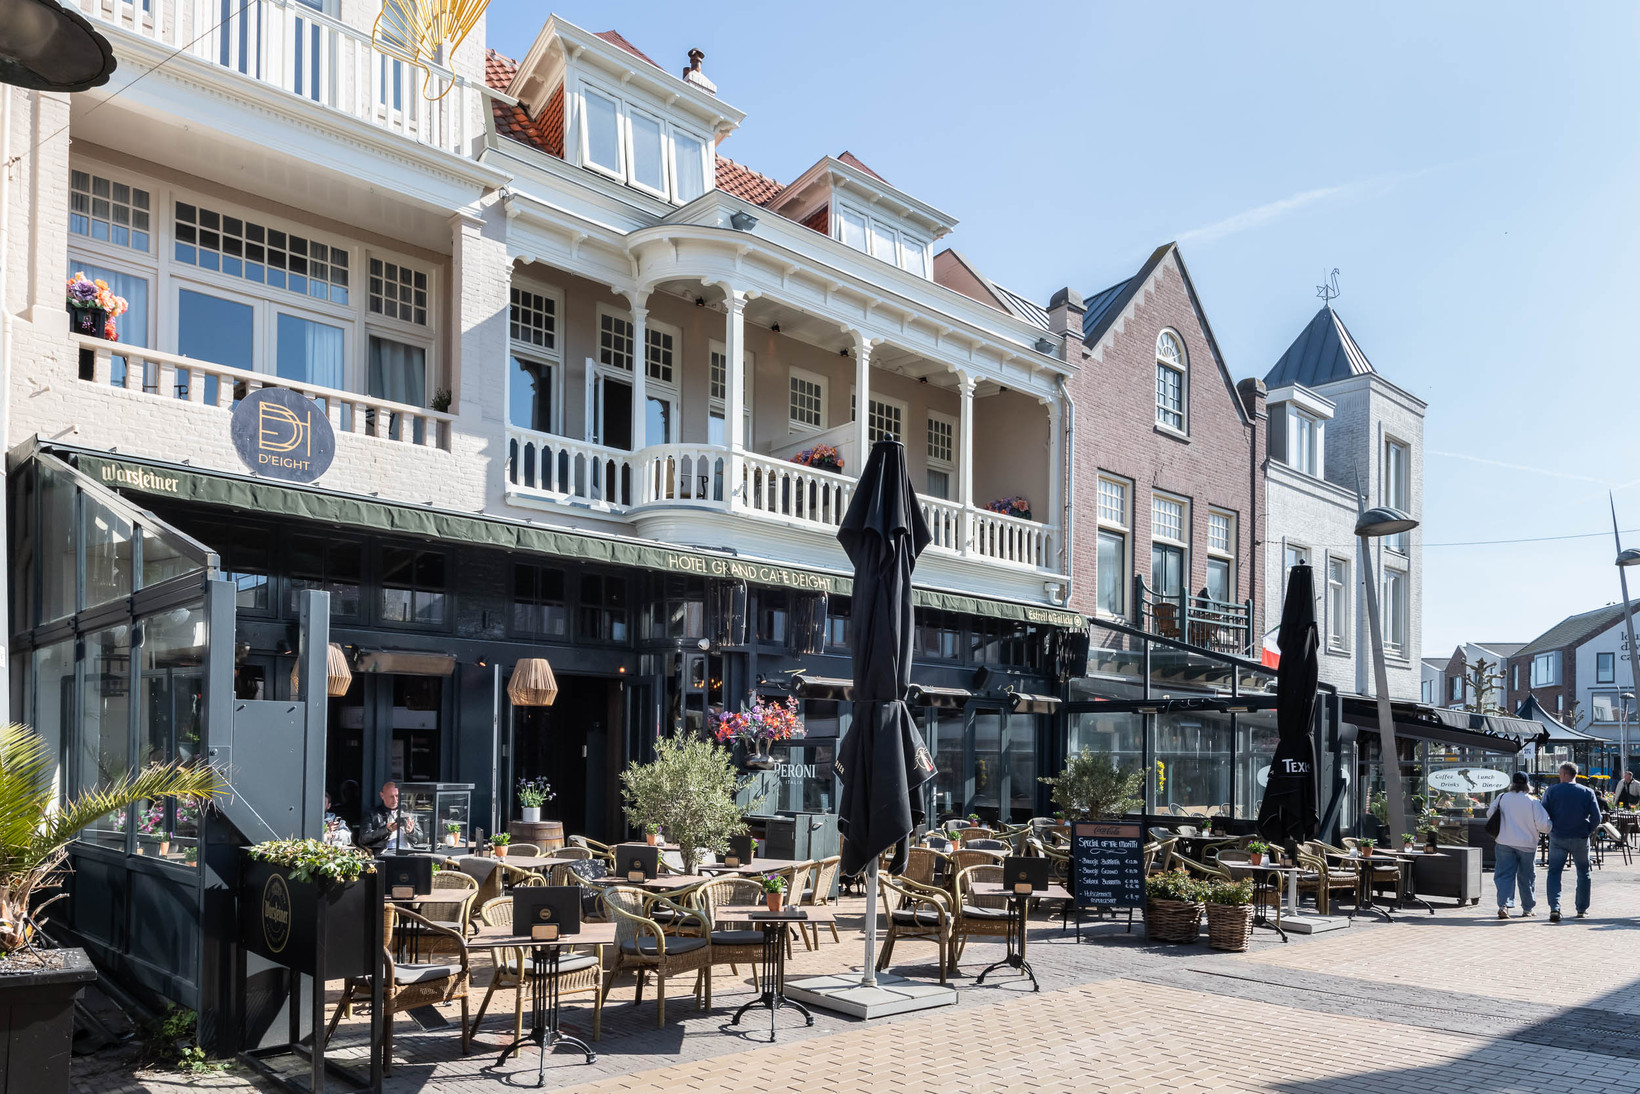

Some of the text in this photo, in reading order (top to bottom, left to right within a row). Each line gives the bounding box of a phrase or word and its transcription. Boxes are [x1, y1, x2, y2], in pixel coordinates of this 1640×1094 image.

[258, 453, 311, 471] D'EIGHT
[102, 464, 179, 493] Warsteiner
[669, 554, 831, 591] HOTEL GRAND CAFE DEIGHT
[774, 762, 816, 778] PERONI
